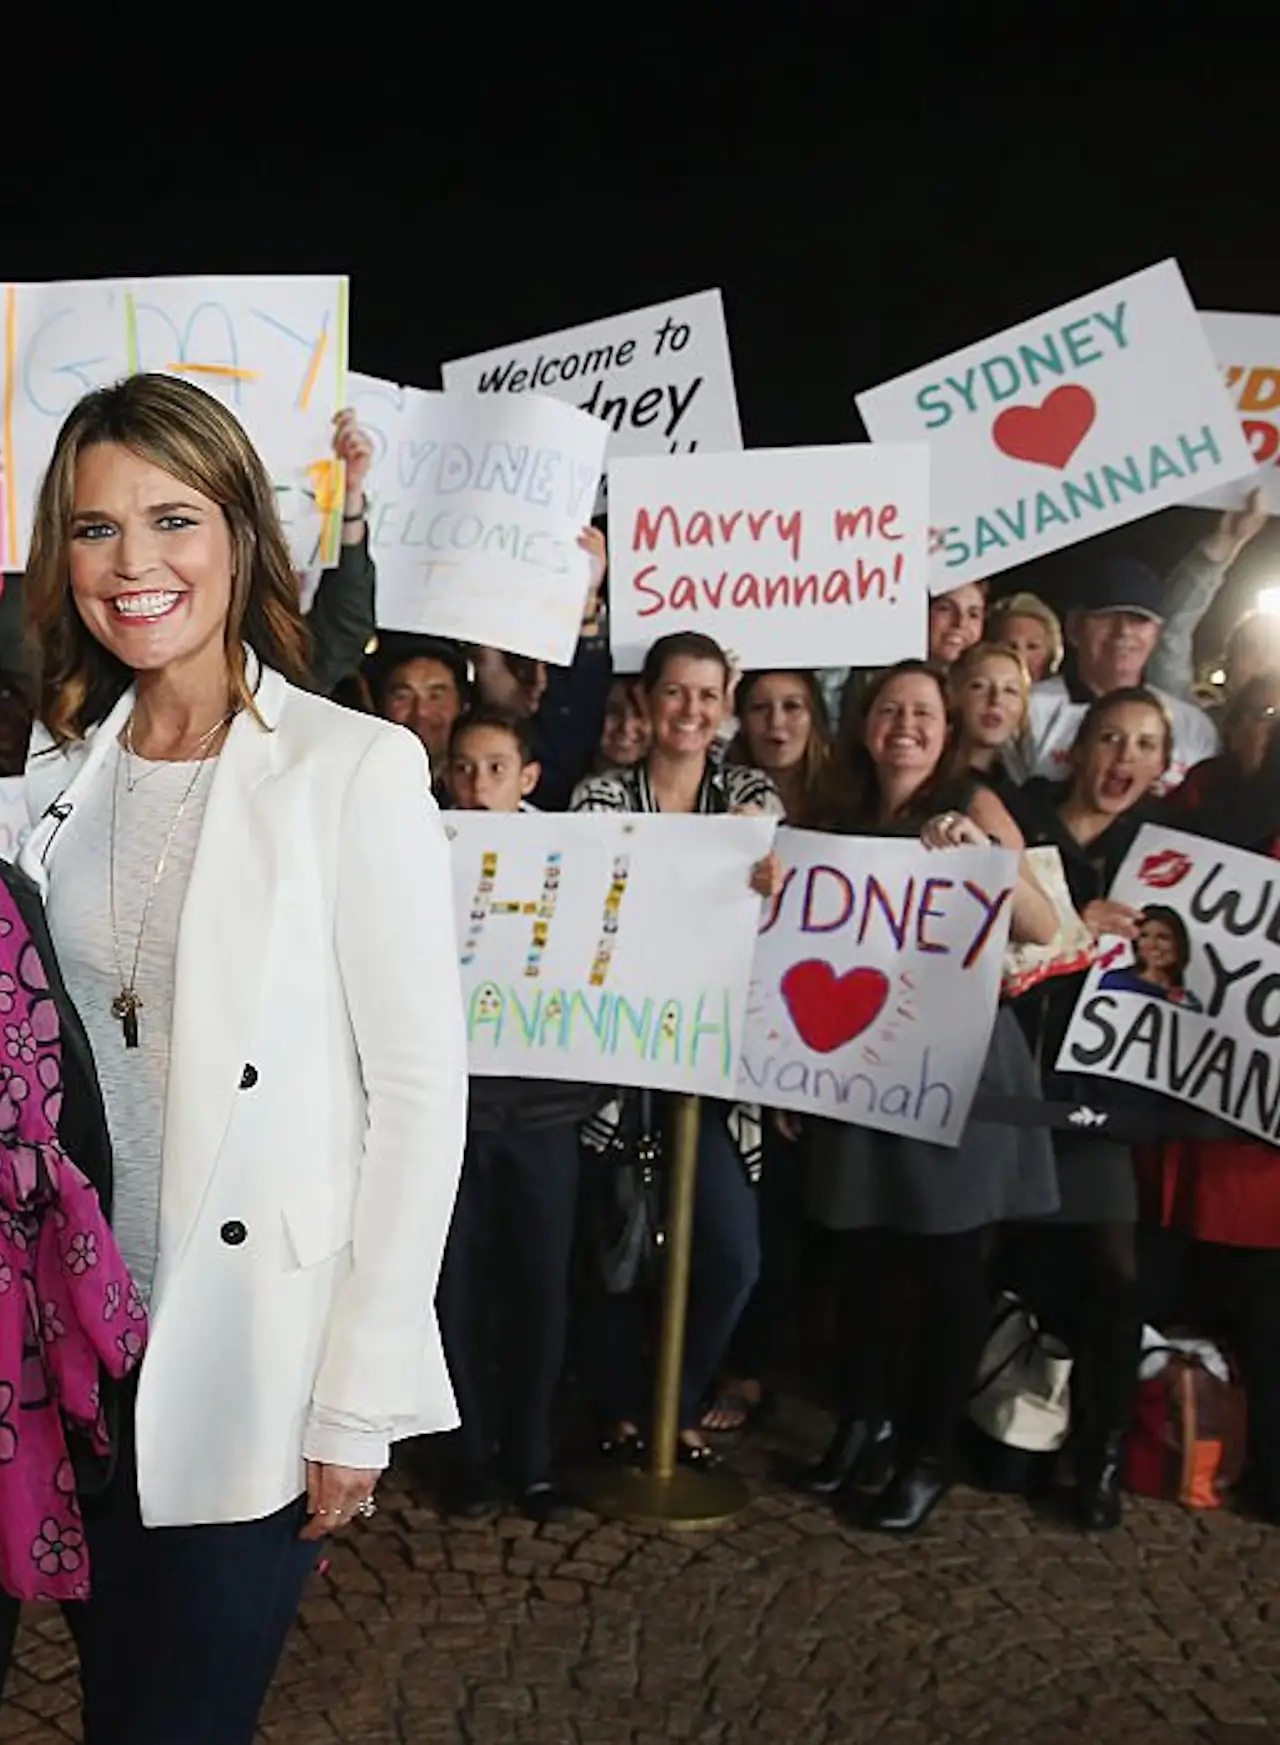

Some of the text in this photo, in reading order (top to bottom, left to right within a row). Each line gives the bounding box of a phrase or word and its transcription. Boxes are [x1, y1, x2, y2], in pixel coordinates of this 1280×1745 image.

[478, 317, 690, 394] Welcome to
[916, 302, 1131, 429] SYDNEY
[633, 504, 904, 561] Marry me
[943, 425, 1223, 568] SAVANNAH
[633, 554, 904, 617] Savannah!
[460, 850, 632, 987] HI
[1190, 863, 1280, 950] W
[1071, 996, 1280, 1142] SAVAN
